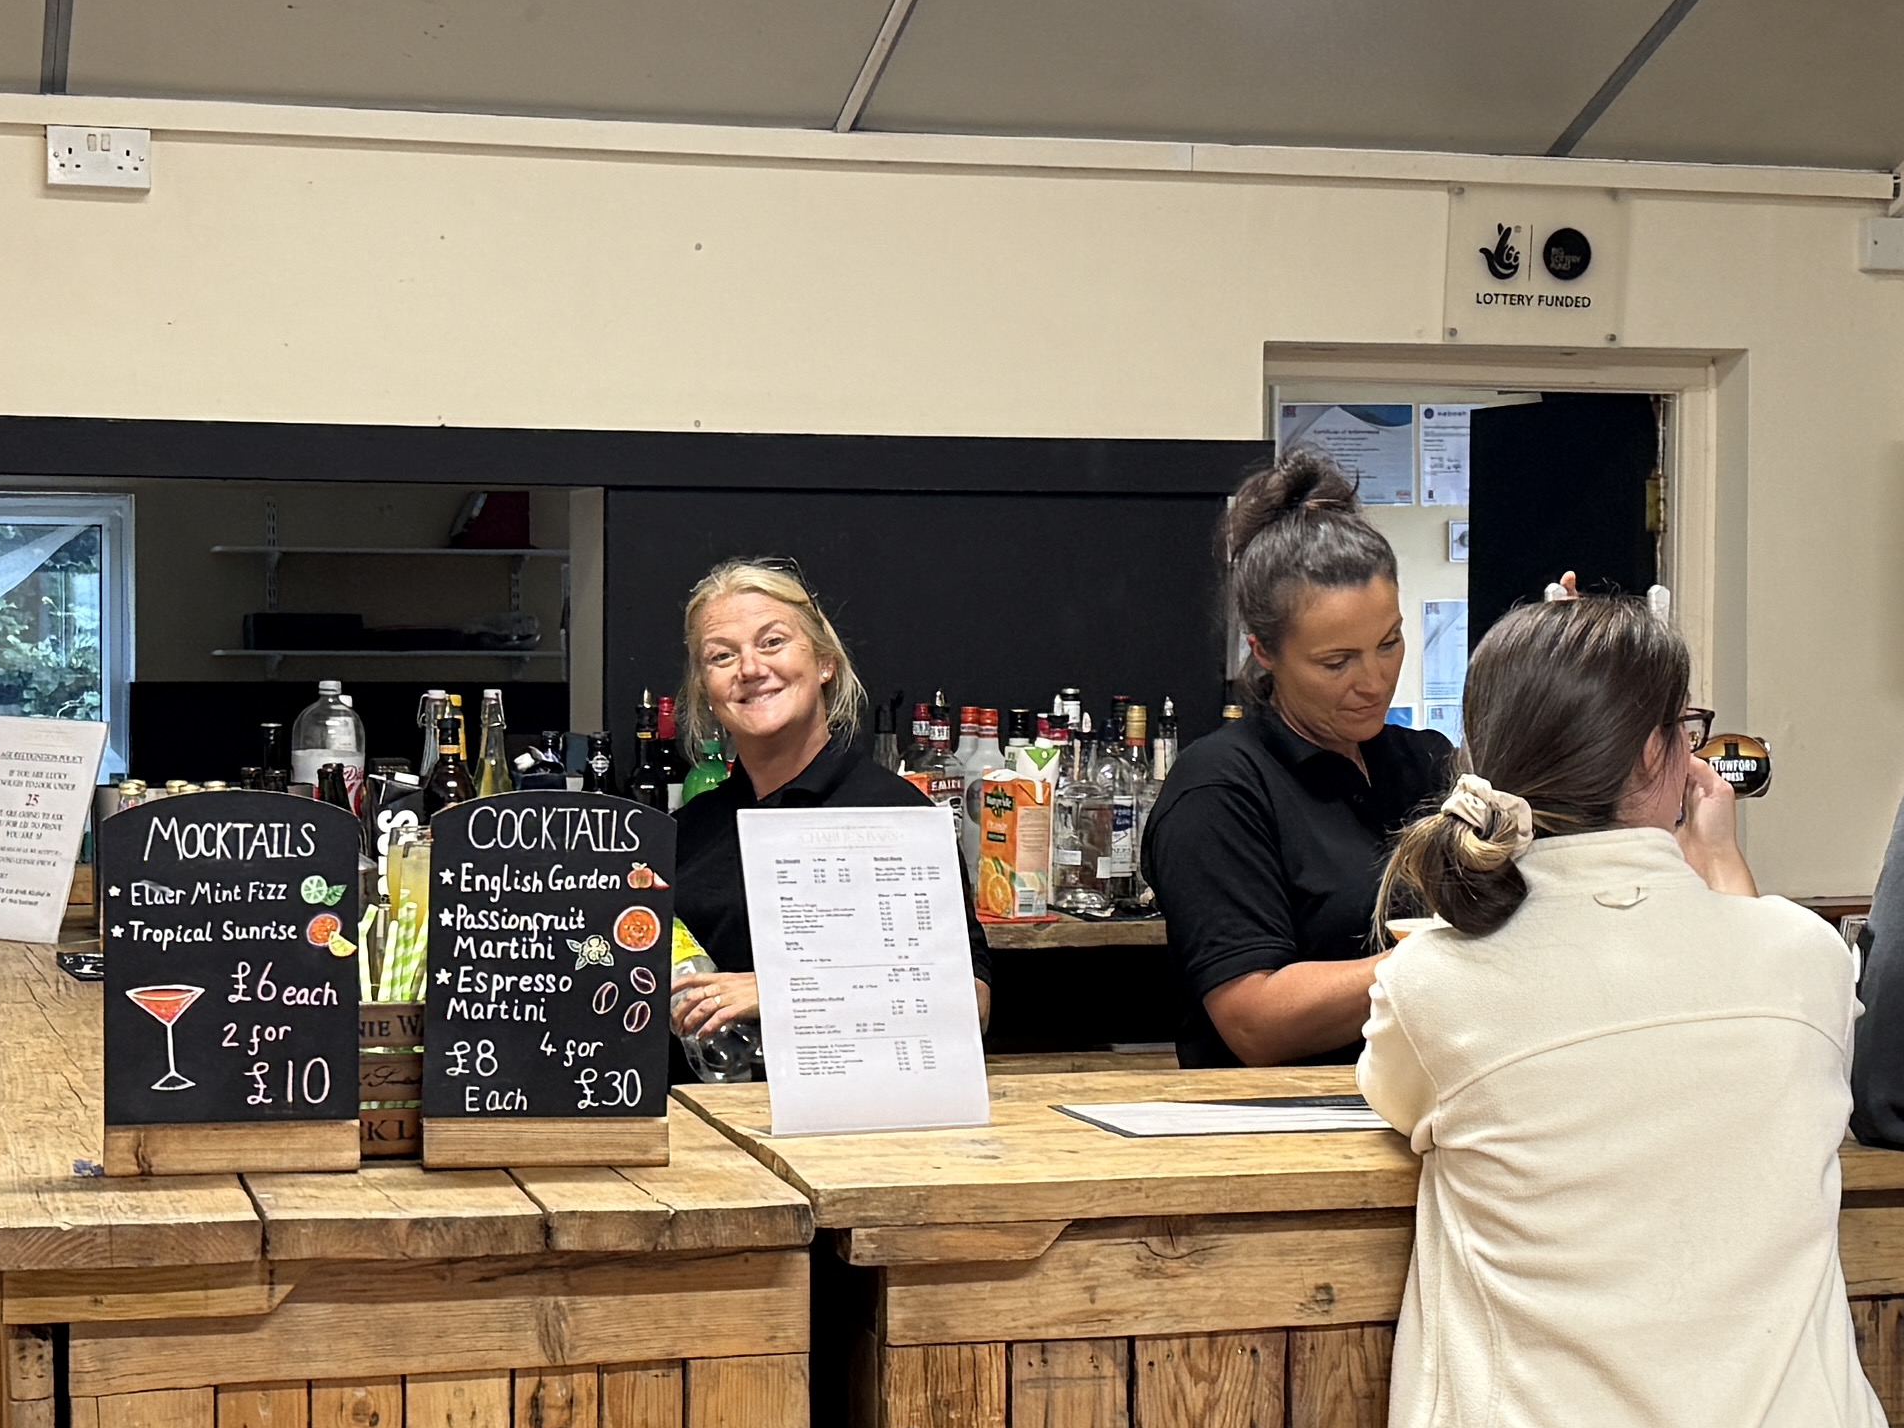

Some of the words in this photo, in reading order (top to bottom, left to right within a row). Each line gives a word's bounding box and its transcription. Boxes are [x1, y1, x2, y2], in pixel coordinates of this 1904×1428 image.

[1476, 293, 1534, 306] LOTTERY
[1538, 295, 1591, 308] FUNDED
[25, 794, 40, 807] 25
[144, 817, 316, 861] MOCKTAILS
[468, 806, 642, 851] COCKTAILS
[191, 882, 241, 905] Mint
[460, 863, 543, 902] English
[549, 865, 620, 890] Garden
[129, 921, 212, 951] Tropical
[223, 921, 297, 941] Sunrise
[456, 904, 585, 942] Passionfruit
[454, 936, 555, 960] Martini
[228, 961, 277, 1003] £6
[283, 982, 338, 1006] each
[457, 966, 572, 1002] Espresso
[447, 997, 546, 1022] Martini
[222, 1023, 240, 1047] 2
[248, 1025, 291, 1056] for
[540, 1032, 556, 1055] 4
[563, 1039, 603, 1067] for
[445, 1039, 498, 1076] £8
[244, 1057, 330, 1104] £10
[574, 1068, 642, 1109] £30
[465, 1086, 527, 1111] Each
